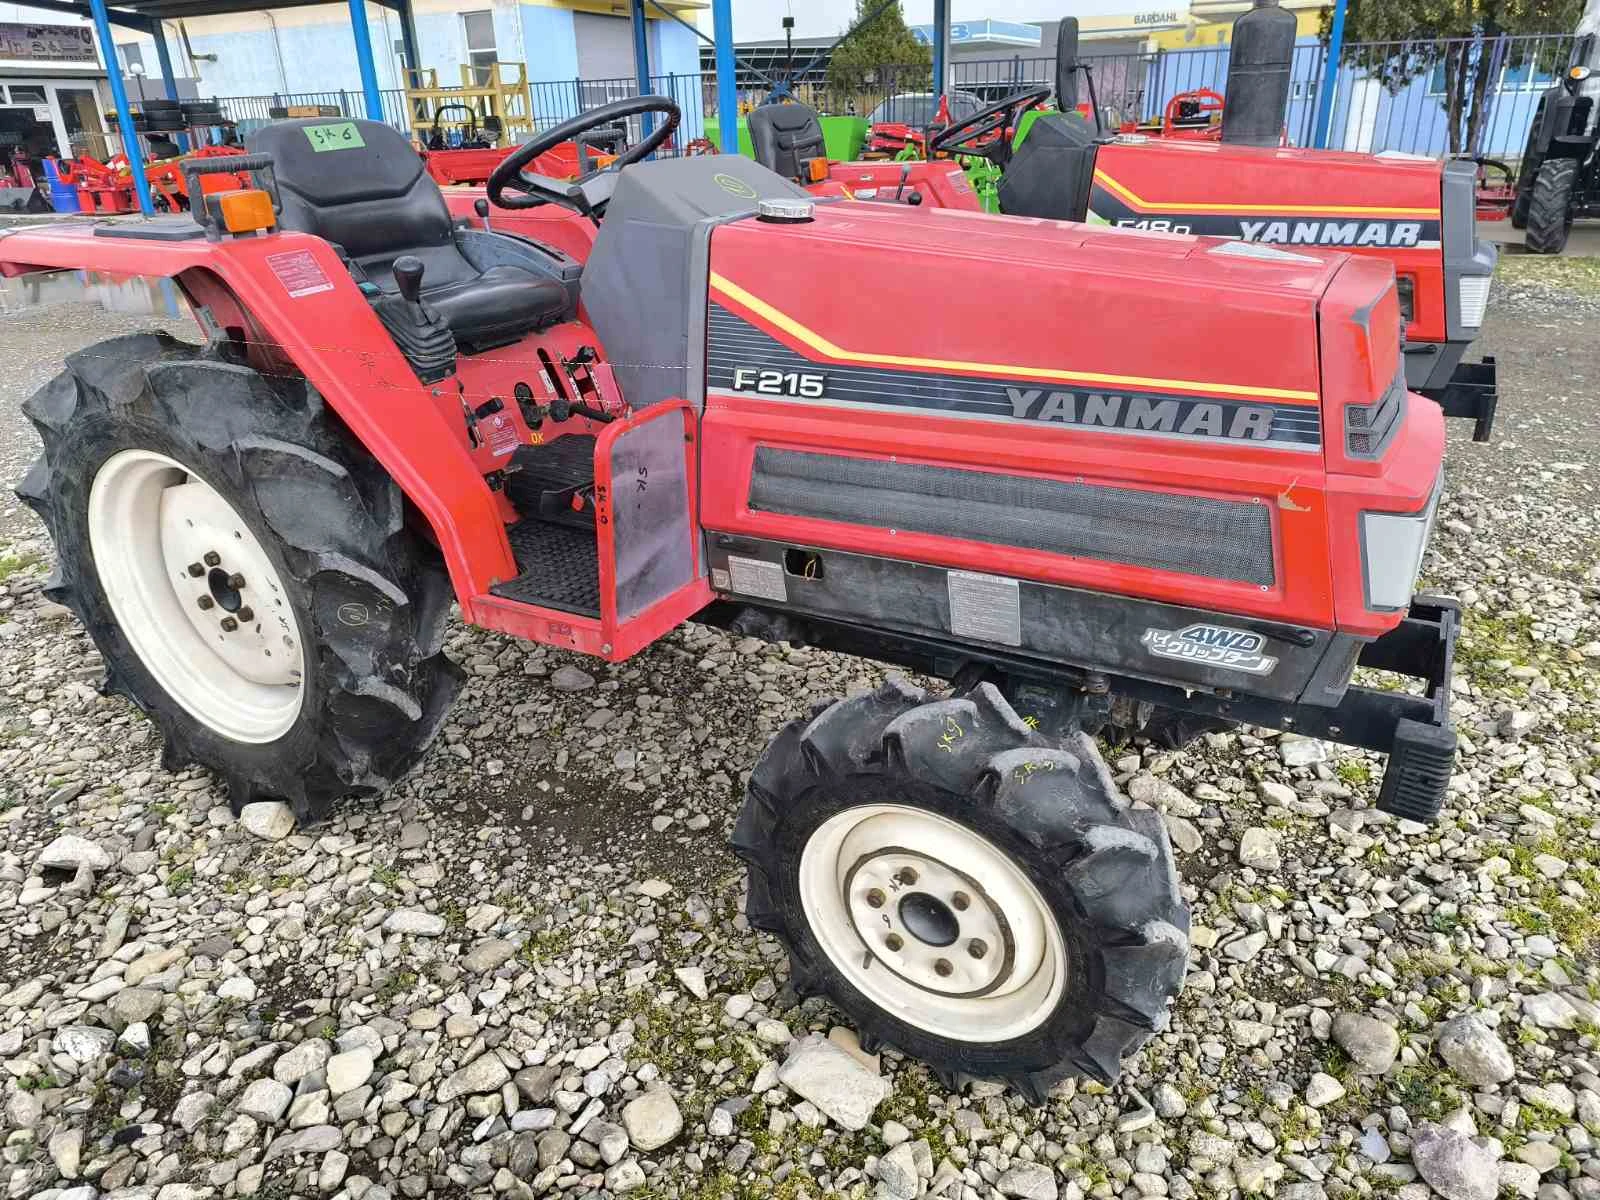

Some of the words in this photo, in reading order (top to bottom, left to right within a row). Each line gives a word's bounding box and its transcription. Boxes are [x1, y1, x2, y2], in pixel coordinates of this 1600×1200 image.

[1134, 12, 1178, 24] BARDAHL
[1239, 221, 1422, 247] YANMAR
[734, 368, 824, 397] F215
[1006, 387, 1275, 440] YANMAR
[1179, 626, 1261, 653] 4WD
